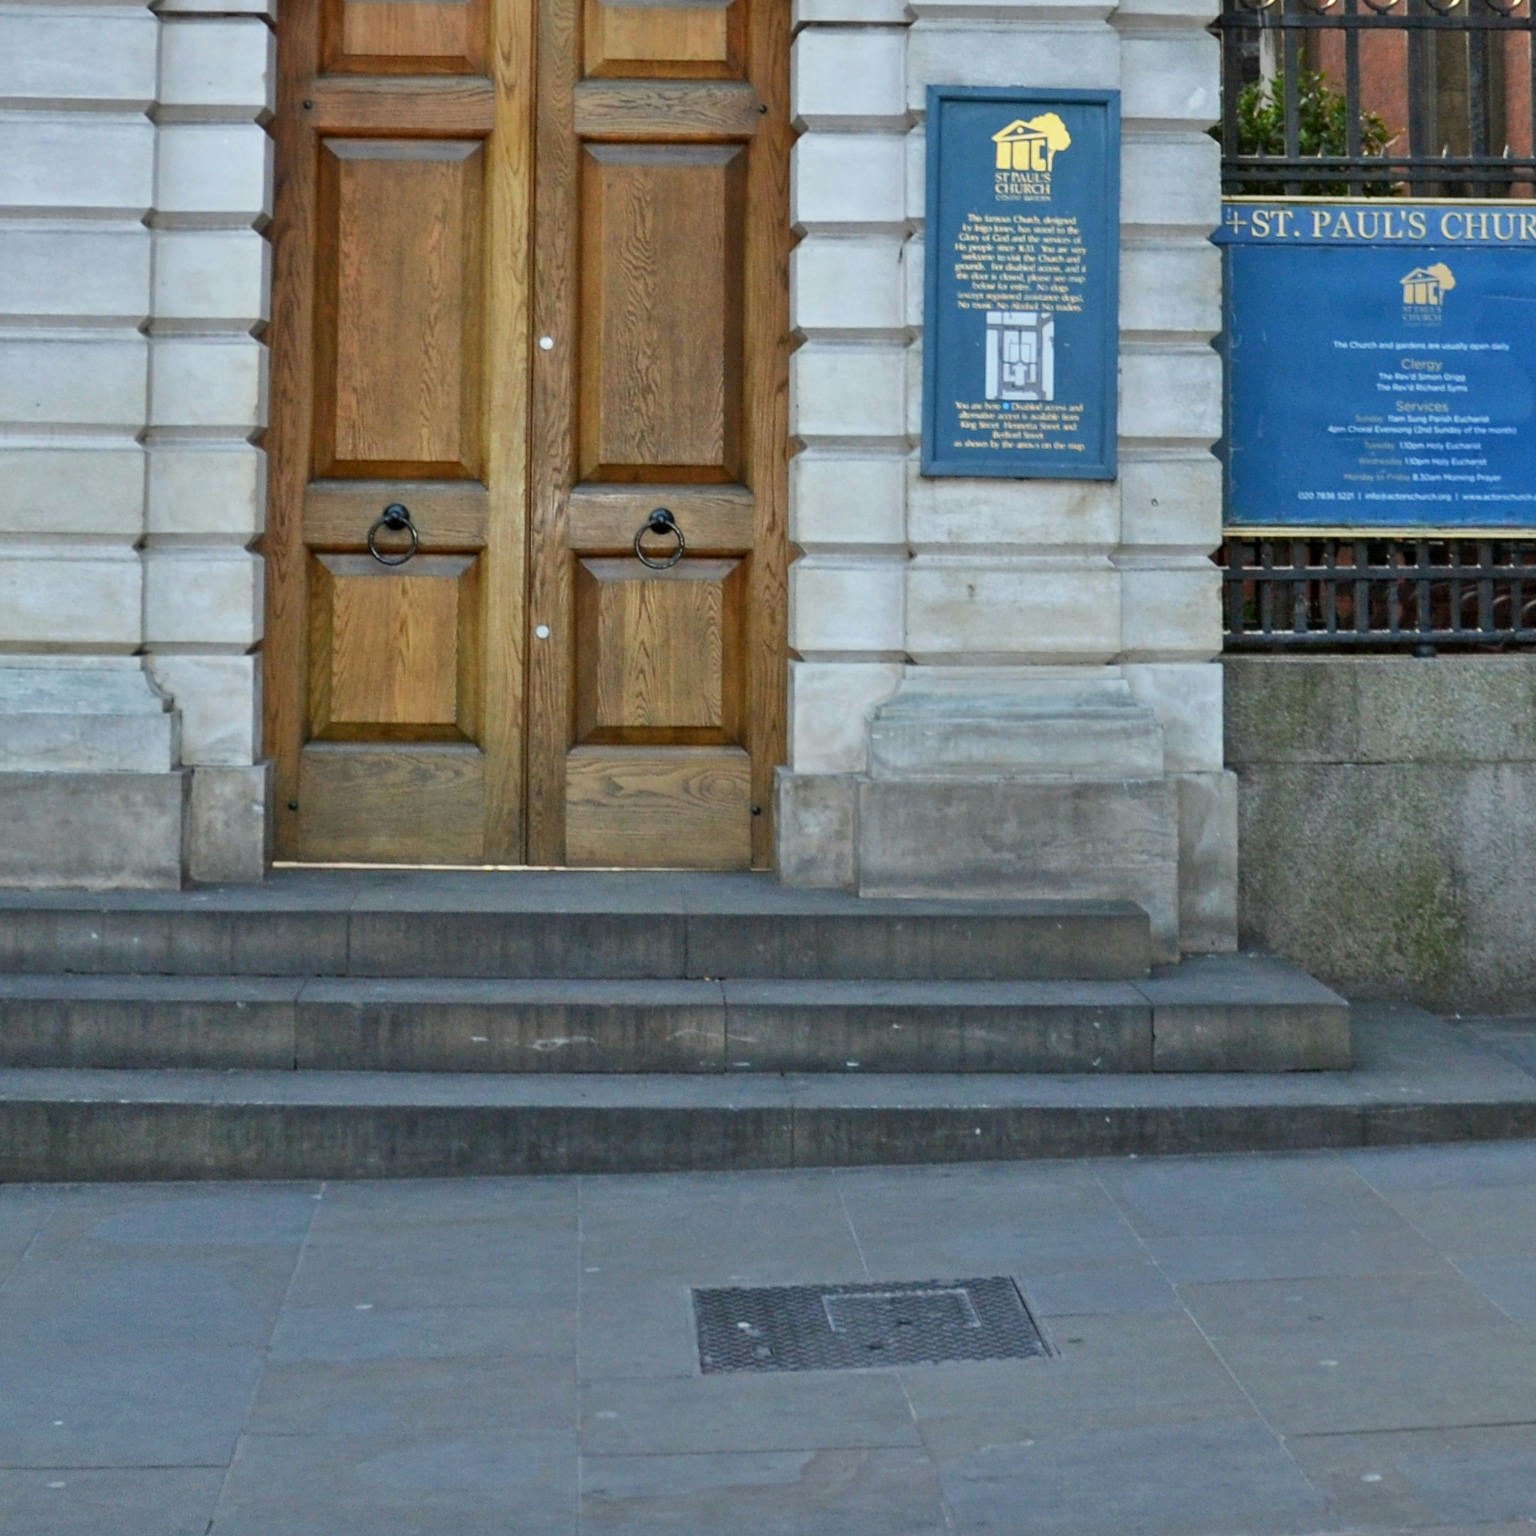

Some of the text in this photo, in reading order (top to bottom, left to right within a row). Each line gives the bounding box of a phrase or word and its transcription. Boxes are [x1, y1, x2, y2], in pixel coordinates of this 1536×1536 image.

[995, 172, 1010, 183] ST
[994, 183, 1051, 195] CHURCH
[1251, 209, 1301, 238] ST.
[1311, 210, 1427, 240] PAUL'S
[1401, 358, 1443, 372] Clergy
[1396, 400, 1450, 413] Services
